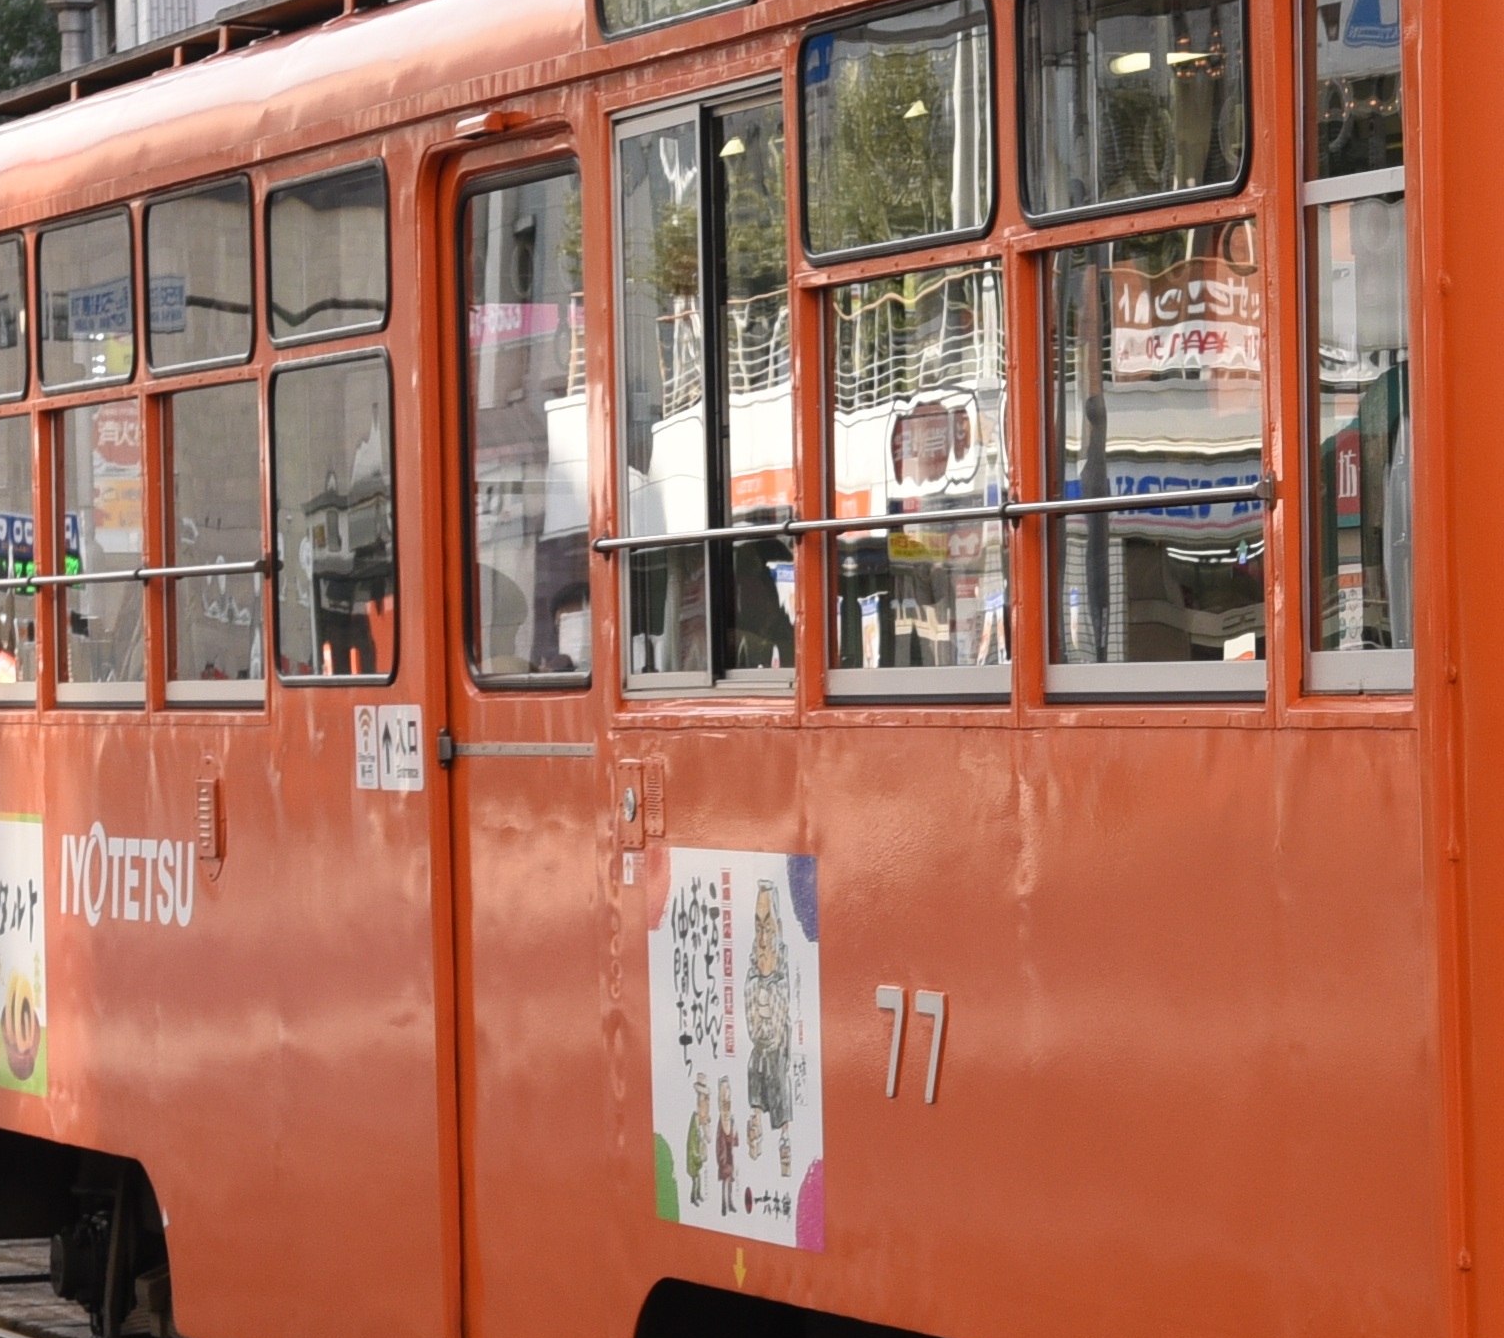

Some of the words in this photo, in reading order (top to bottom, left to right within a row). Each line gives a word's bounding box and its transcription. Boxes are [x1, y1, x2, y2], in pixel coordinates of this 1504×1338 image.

[395, 718, 418, 756] 入口
[60, 821, 194, 927] IYOTETSU
[877, 985, 946, 1104] 77
